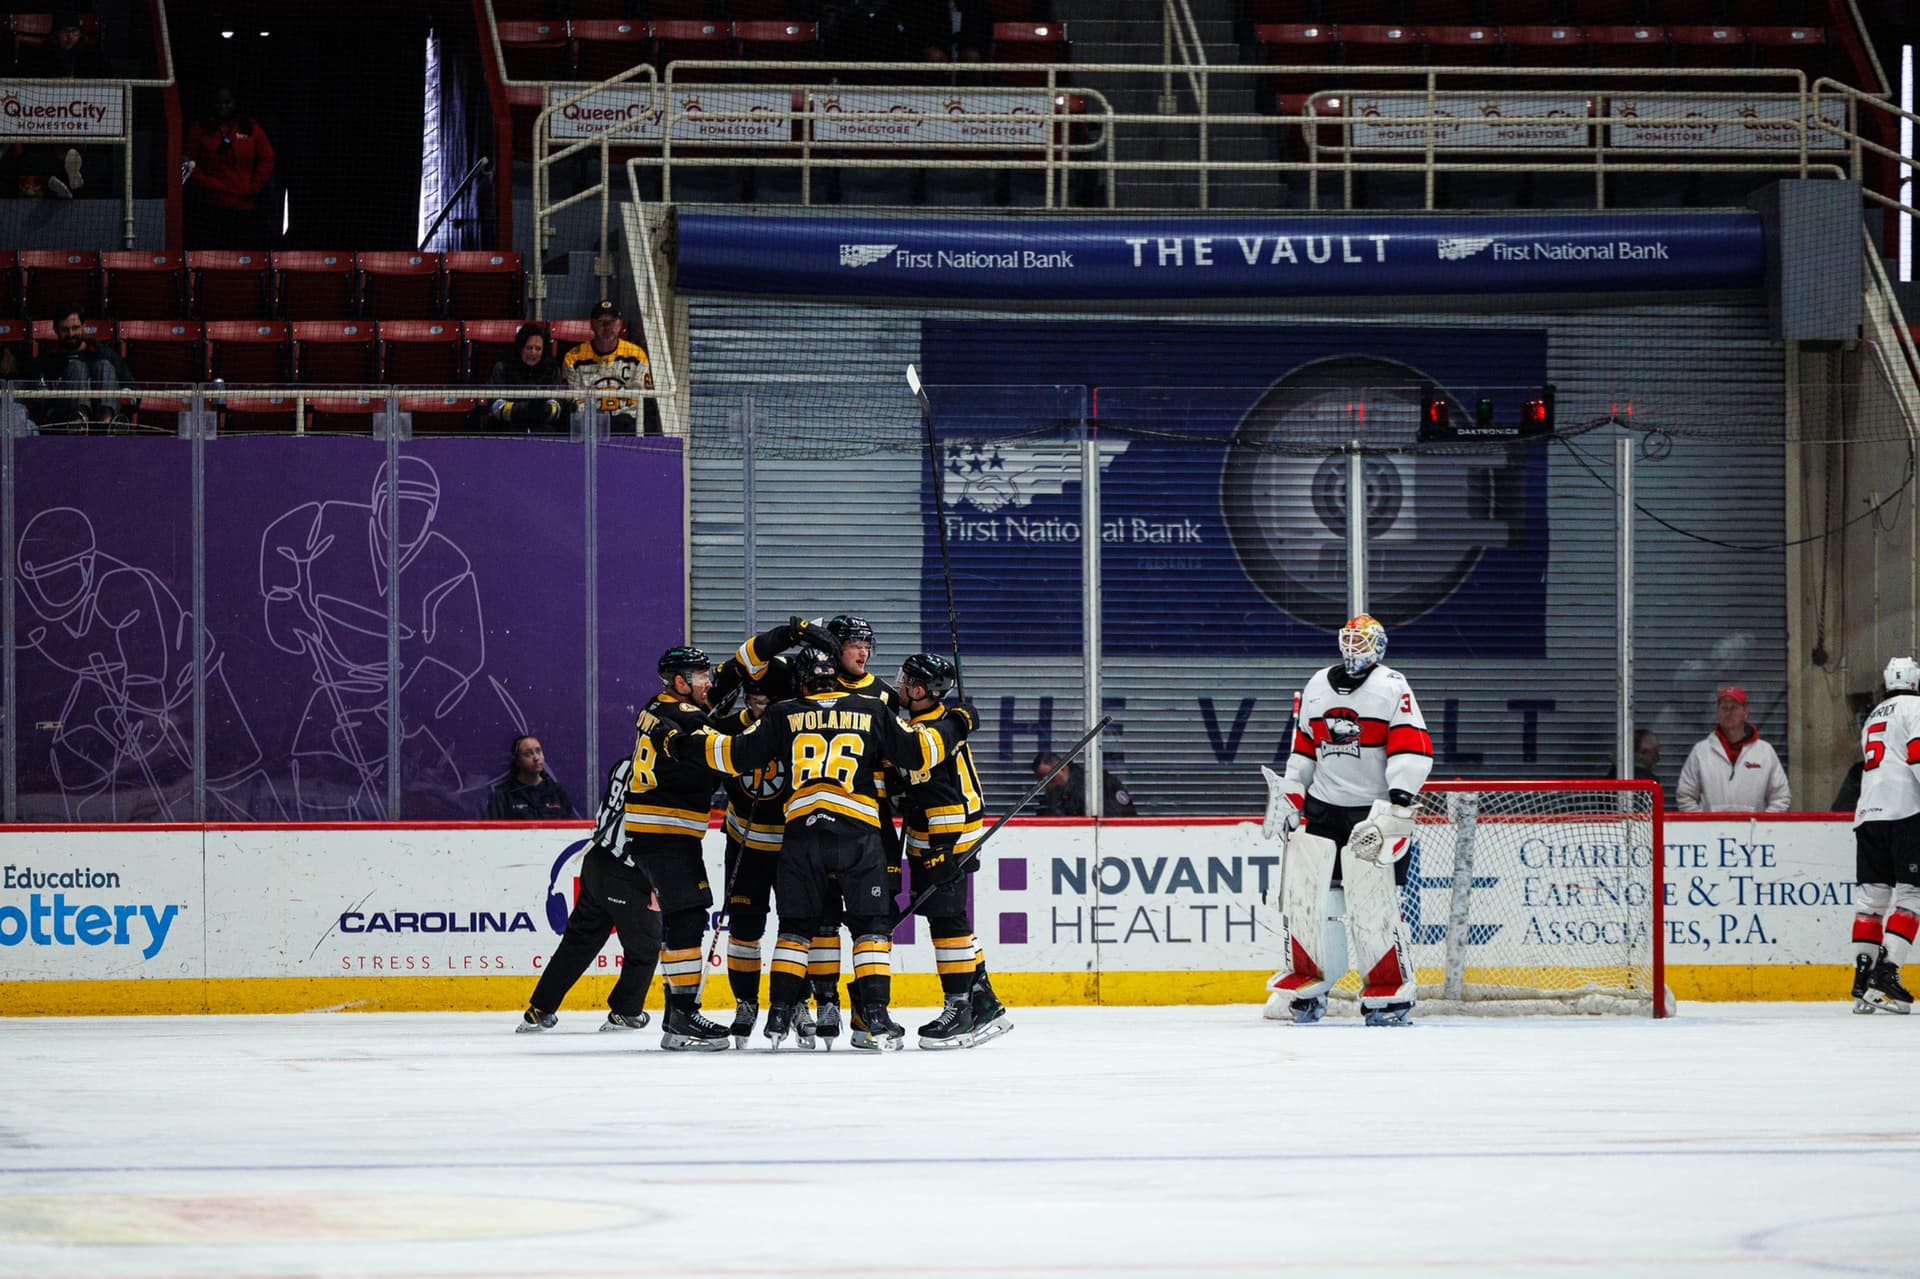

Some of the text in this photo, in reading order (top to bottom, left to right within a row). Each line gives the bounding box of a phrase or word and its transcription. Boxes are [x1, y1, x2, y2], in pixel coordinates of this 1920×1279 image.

[4, 100, 106, 122] QueenCity
[18, 122, 89, 130] HOMESTORE
[577, 124, 647, 133] HOMORE
[700, 126, 769, 135] HOMESTORE
[839, 126, 910, 134] HOMESTORE
[962, 127, 1031, 136] HOMESTORE
[1378, 130, 1447, 139] HOMESTRE
[1498, 130, 1568, 139] HOMESTORE
[1636, 132, 1704, 141] HOMESTORE
[1755, 134, 1824, 142] HOMESTRE
[896, 250, 1074, 269] First National Bank
[1125, 235, 1390, 267] THE VAULT
[1493, 240, 1669, 261] First National Bank
[1457, 428, 1519, 436] DAKTRONICS
[945, 516, 1203, 543] First Natioal Bank
[1400, 693, 1412, 714] 3
[787, 710, 872, 733] WOLANIN
[1863, 721, 1887, 772] 5
[792, 733, 865, 794] 86
[4, 865, 121, 889] Education
[1052, 856, 1280, 895] NOVANT
[1592, 876, 1678, 907] NOE
[1688, 876, 1720, 907] &
[340, 912, 537, 933] CAROLINA
[1052, 905, 1256, 944] HEALTH
[1522, 914, 1777, 951] ASSOCIAES, P.A.
[342, 955, 431, 970] STRESS
